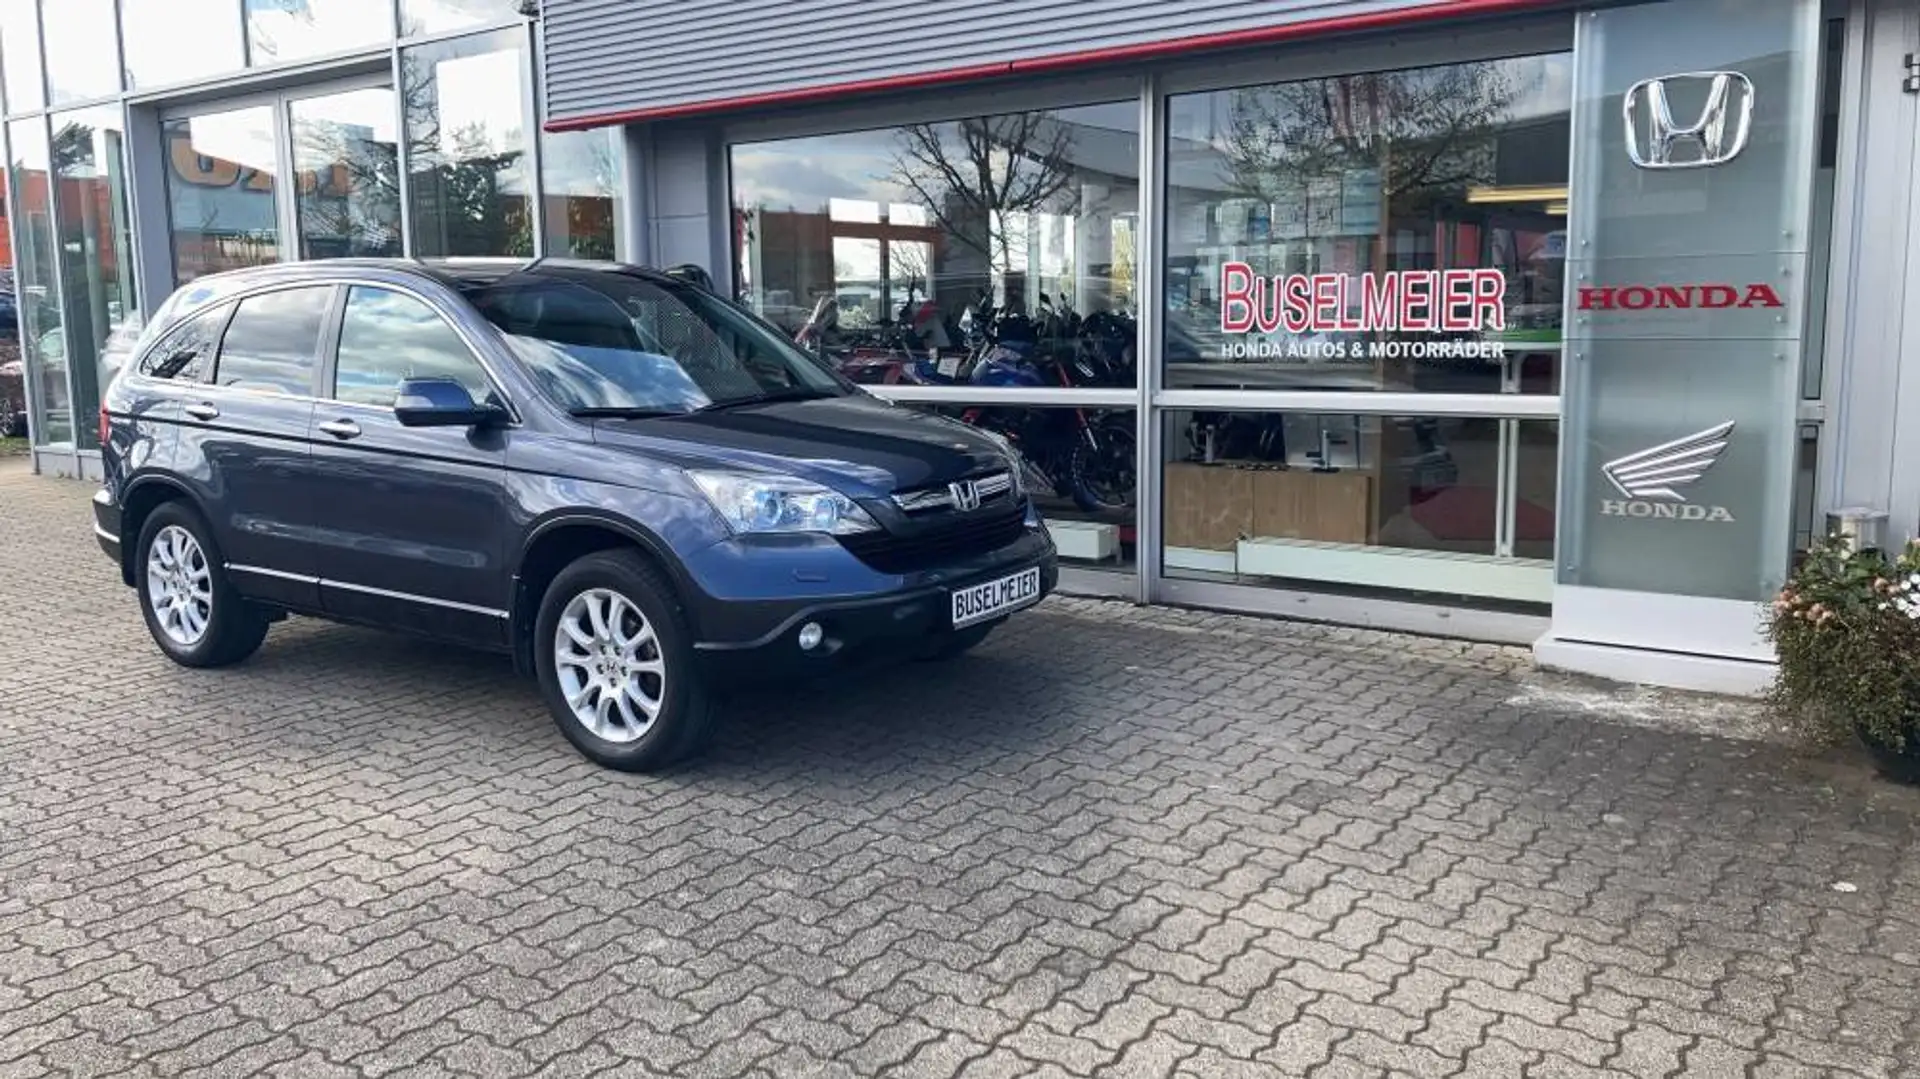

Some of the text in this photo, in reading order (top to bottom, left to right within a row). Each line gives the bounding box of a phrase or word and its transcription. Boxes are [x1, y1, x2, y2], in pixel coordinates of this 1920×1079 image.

[1221, 261, 1506, 334] BUSELMEIER
[1577, 283, 1785, 311] HONDA
[1221, 338, 1506, 359] HONDA AUTOS & MOTORRÄDER
[1600, 499, 1736, 522] HONDA
[955, 571, 1037, 620] BUSELMEIER
